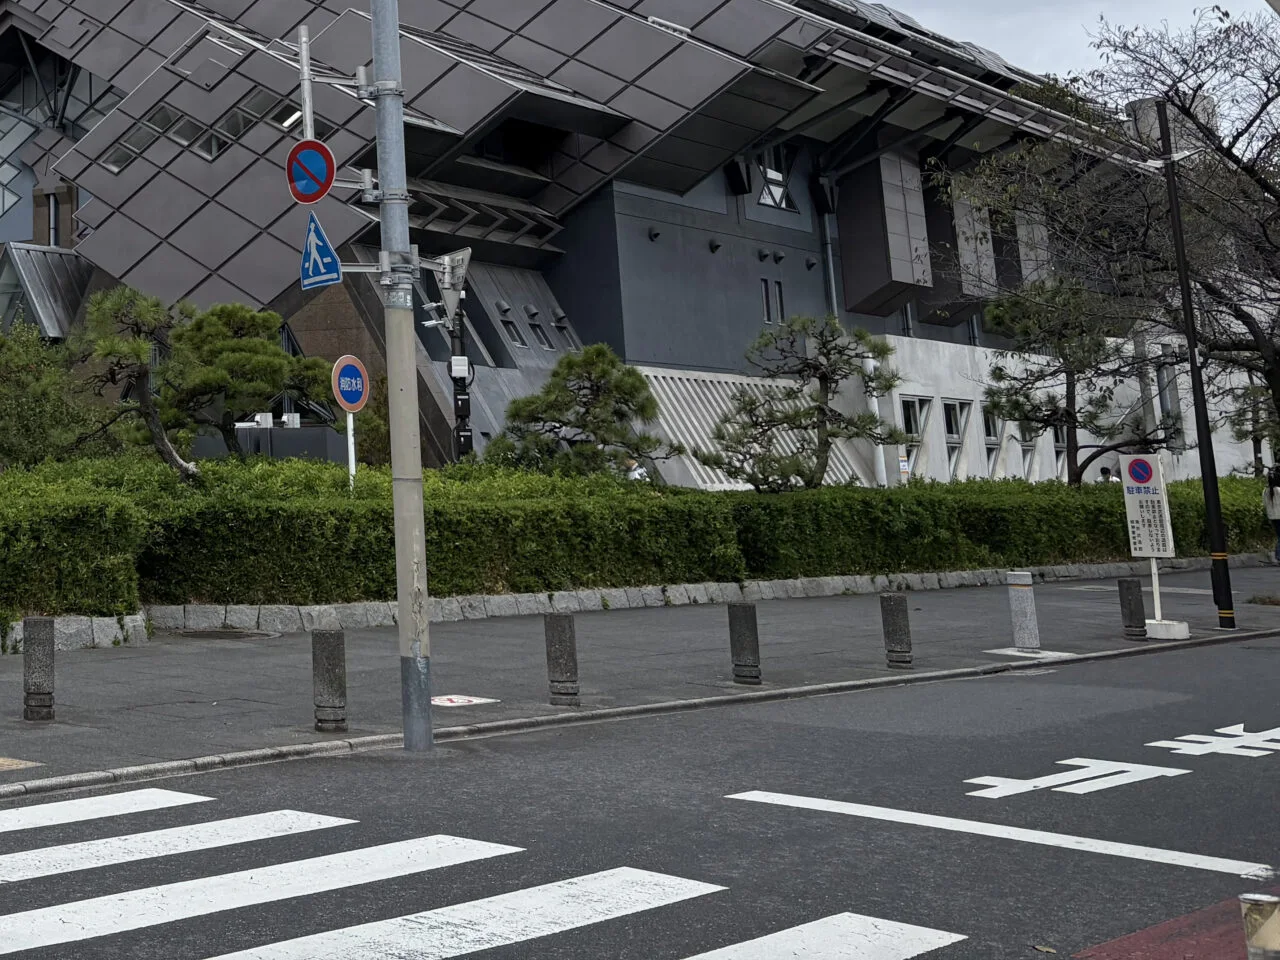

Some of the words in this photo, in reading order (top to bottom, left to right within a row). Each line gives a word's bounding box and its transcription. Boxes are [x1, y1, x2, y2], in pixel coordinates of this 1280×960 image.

[340, 376, 363, 392] 消防水利
[1126, 486, 1160, 495] 駐車禁止
